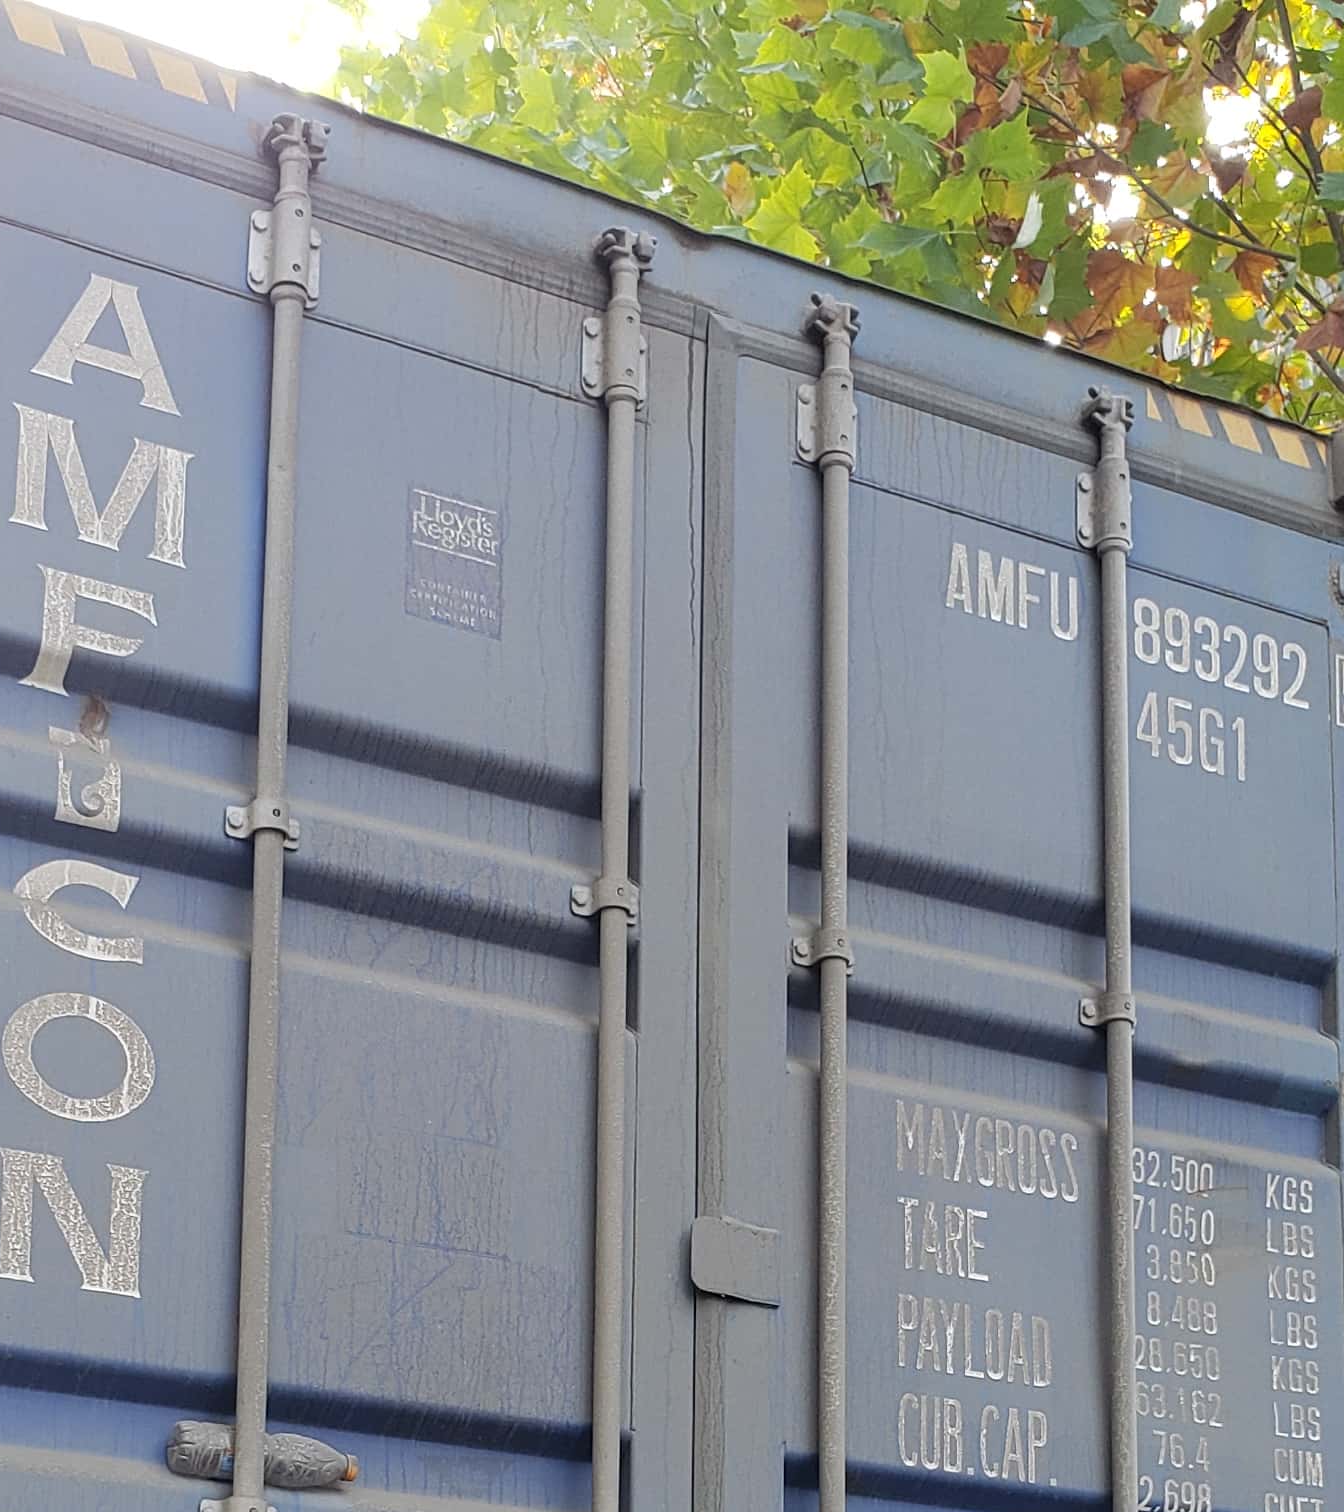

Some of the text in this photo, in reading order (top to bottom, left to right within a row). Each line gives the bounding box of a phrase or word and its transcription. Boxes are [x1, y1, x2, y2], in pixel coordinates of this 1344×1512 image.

[413, 510, 498, 556] Register
[419, 495, 494, 538] Lloyd's
[945, 542, 1079, 641] AMFU
[1133, 597, 1310, 710] 893292
[1136, 691, 1246, 782] 45G1
[1264, 1172, 1313, 1214] KGS
[897, 1197, 990, 1283] TARE
[1267, 1264, 1317, 1304] KGS
[1265, 1218, 1315, 1259] LBS
[896, 1294, 1053, 1388] PAYLOAD
[1271, 1355, 1320, 1395] KGS
[1270, 1309, 1319, 1350] LBS
[898, 1393, 1324, 1488] CUB.CAP. 76.4 CUM
[1273, 1401, 1322, 1441] LBS
